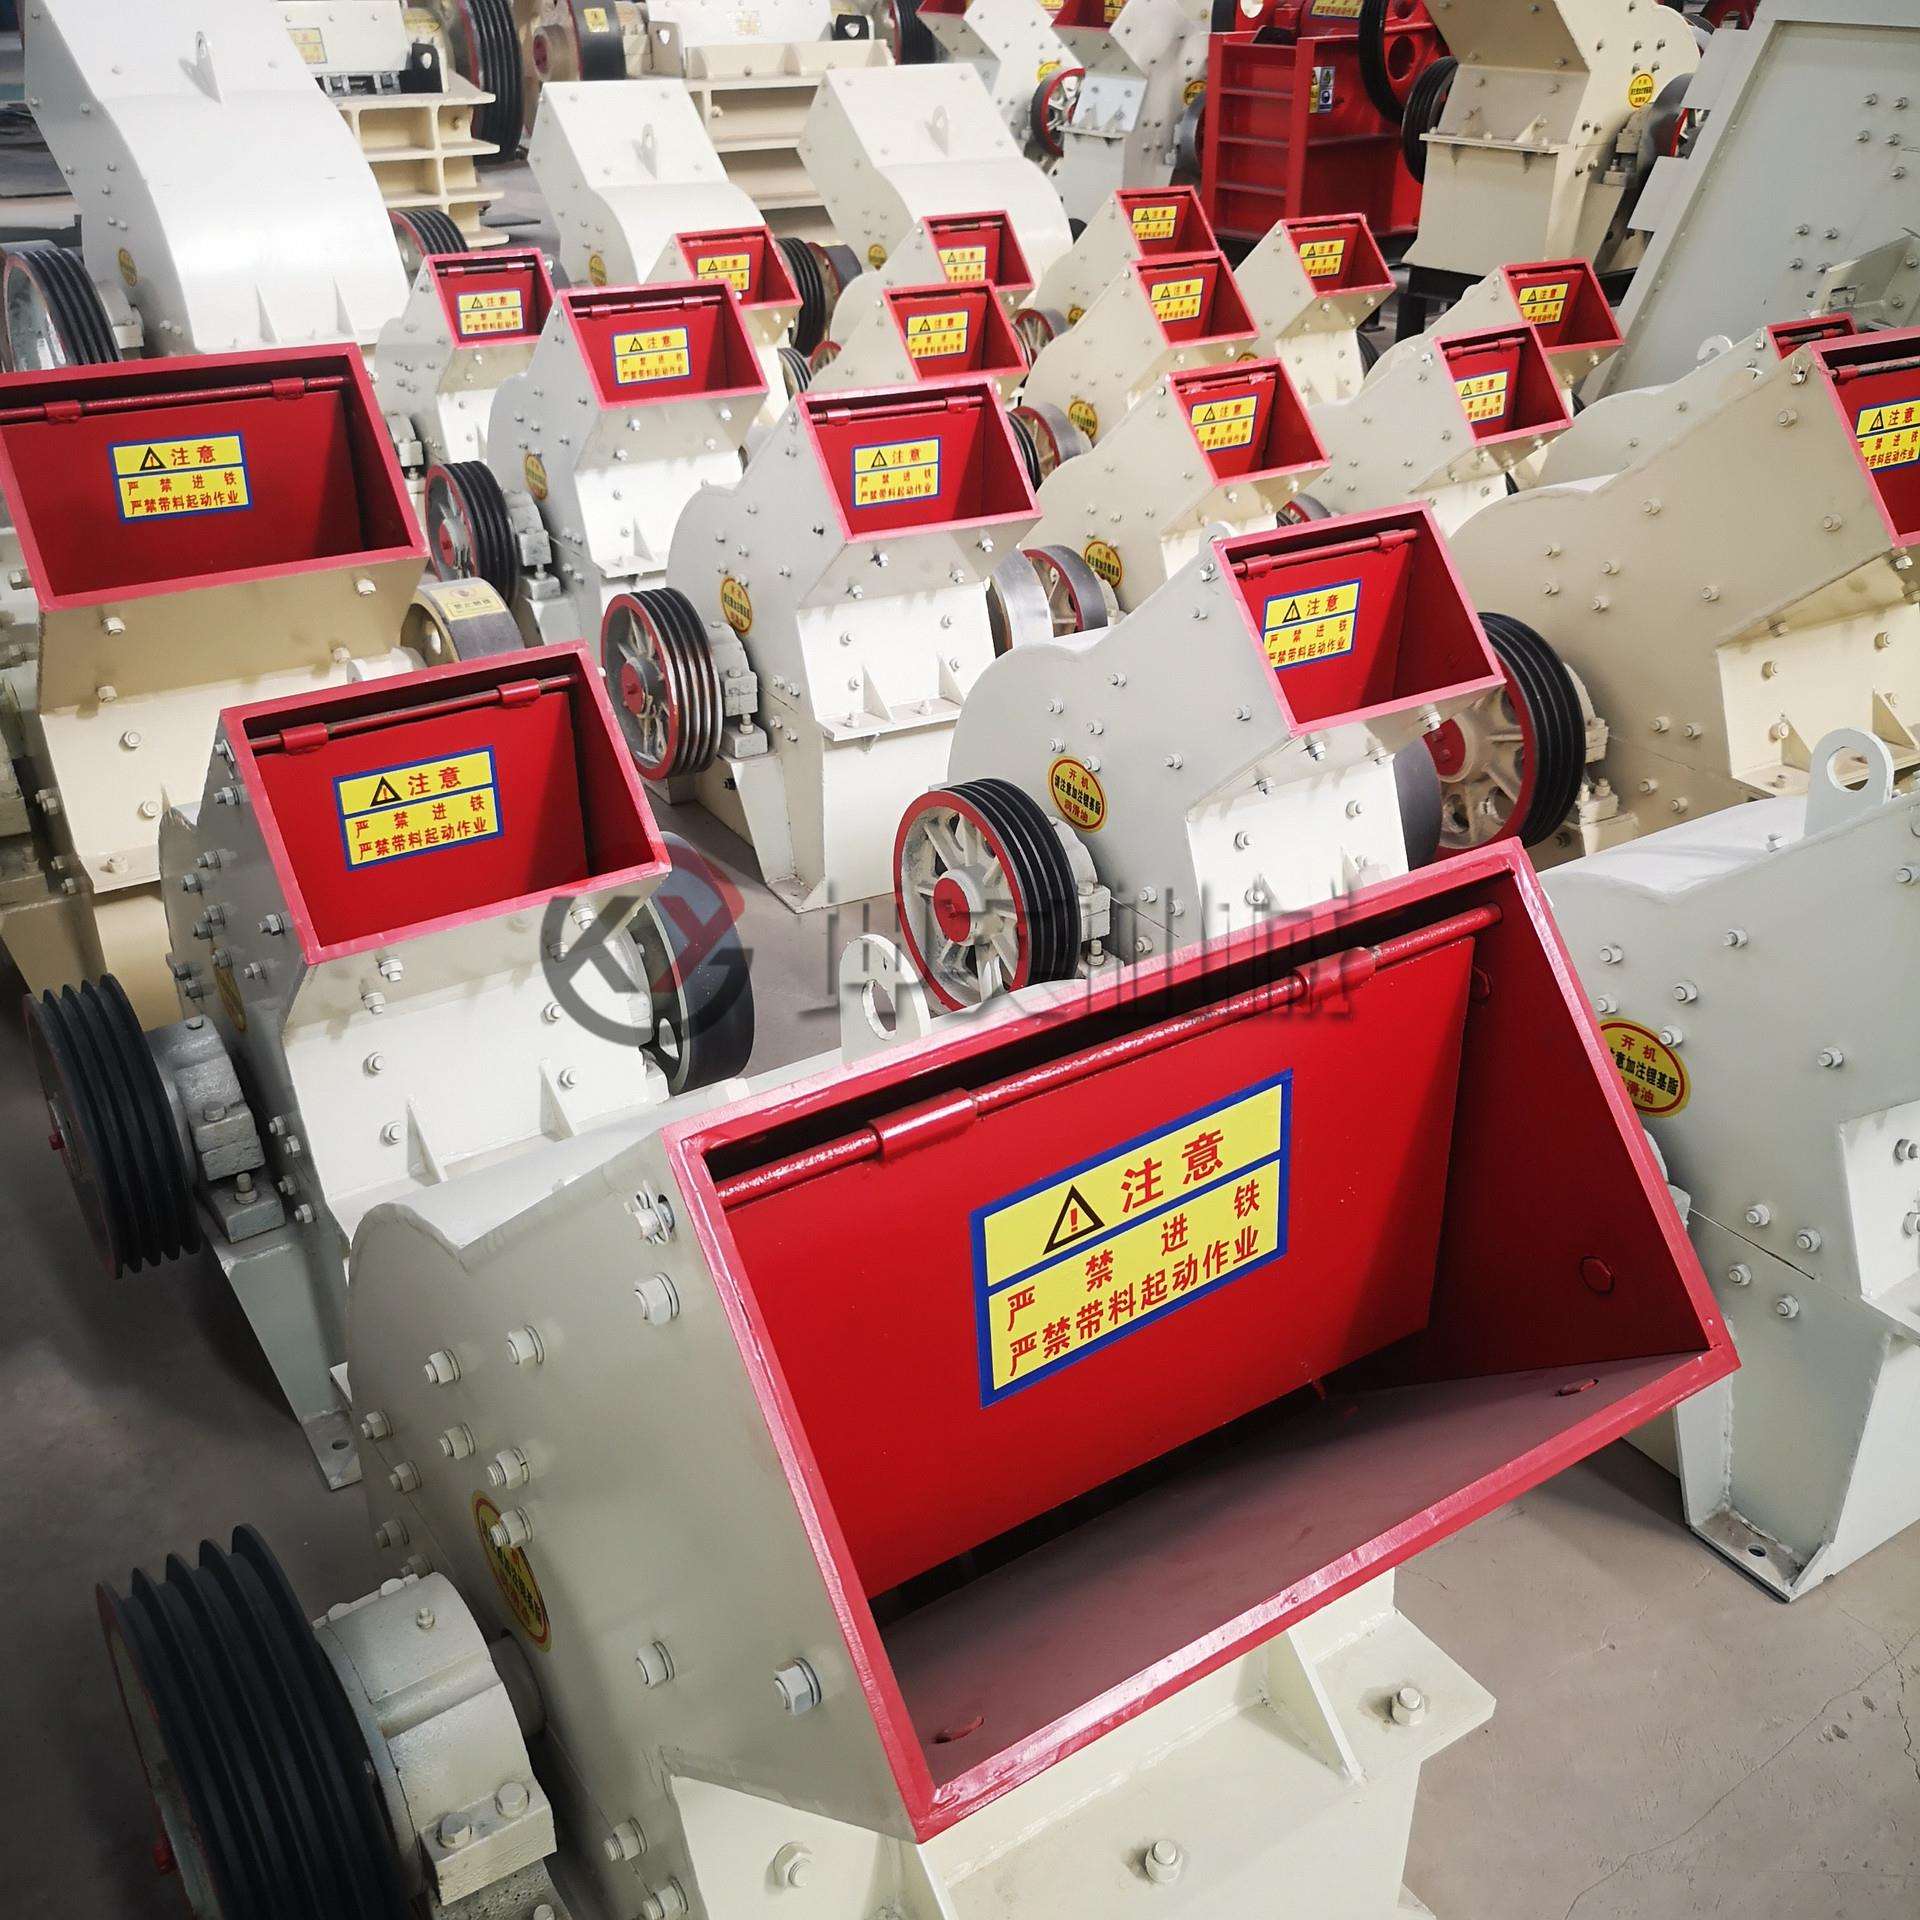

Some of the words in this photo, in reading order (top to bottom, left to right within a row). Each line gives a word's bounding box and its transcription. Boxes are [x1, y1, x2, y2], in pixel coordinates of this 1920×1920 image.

[1888, 407, 1914, 426] 注意
[171, 445, 216, 466] 注意
[892, 448, 920, 464] 注意
[127, 471, 237, 496] 严禁进铁
[130, 490, 238, 514] 严禁带料起动作业
[1307, 594, 1339, 616] 注意
[408, 766, 461, 796] 注意
[355, 794, 485, 839] 严禁进铁
[358, 817, 487, 860] 严禁带料起动作业
[1621, 1034, 1656, 1063] 开机
[1121, 1129, 1224, 1213] 注意
[1007, 1180, 1260, 1331] 严禁进铁
[1010, 1225, 1259, 1377] 严禁带料起动作业
